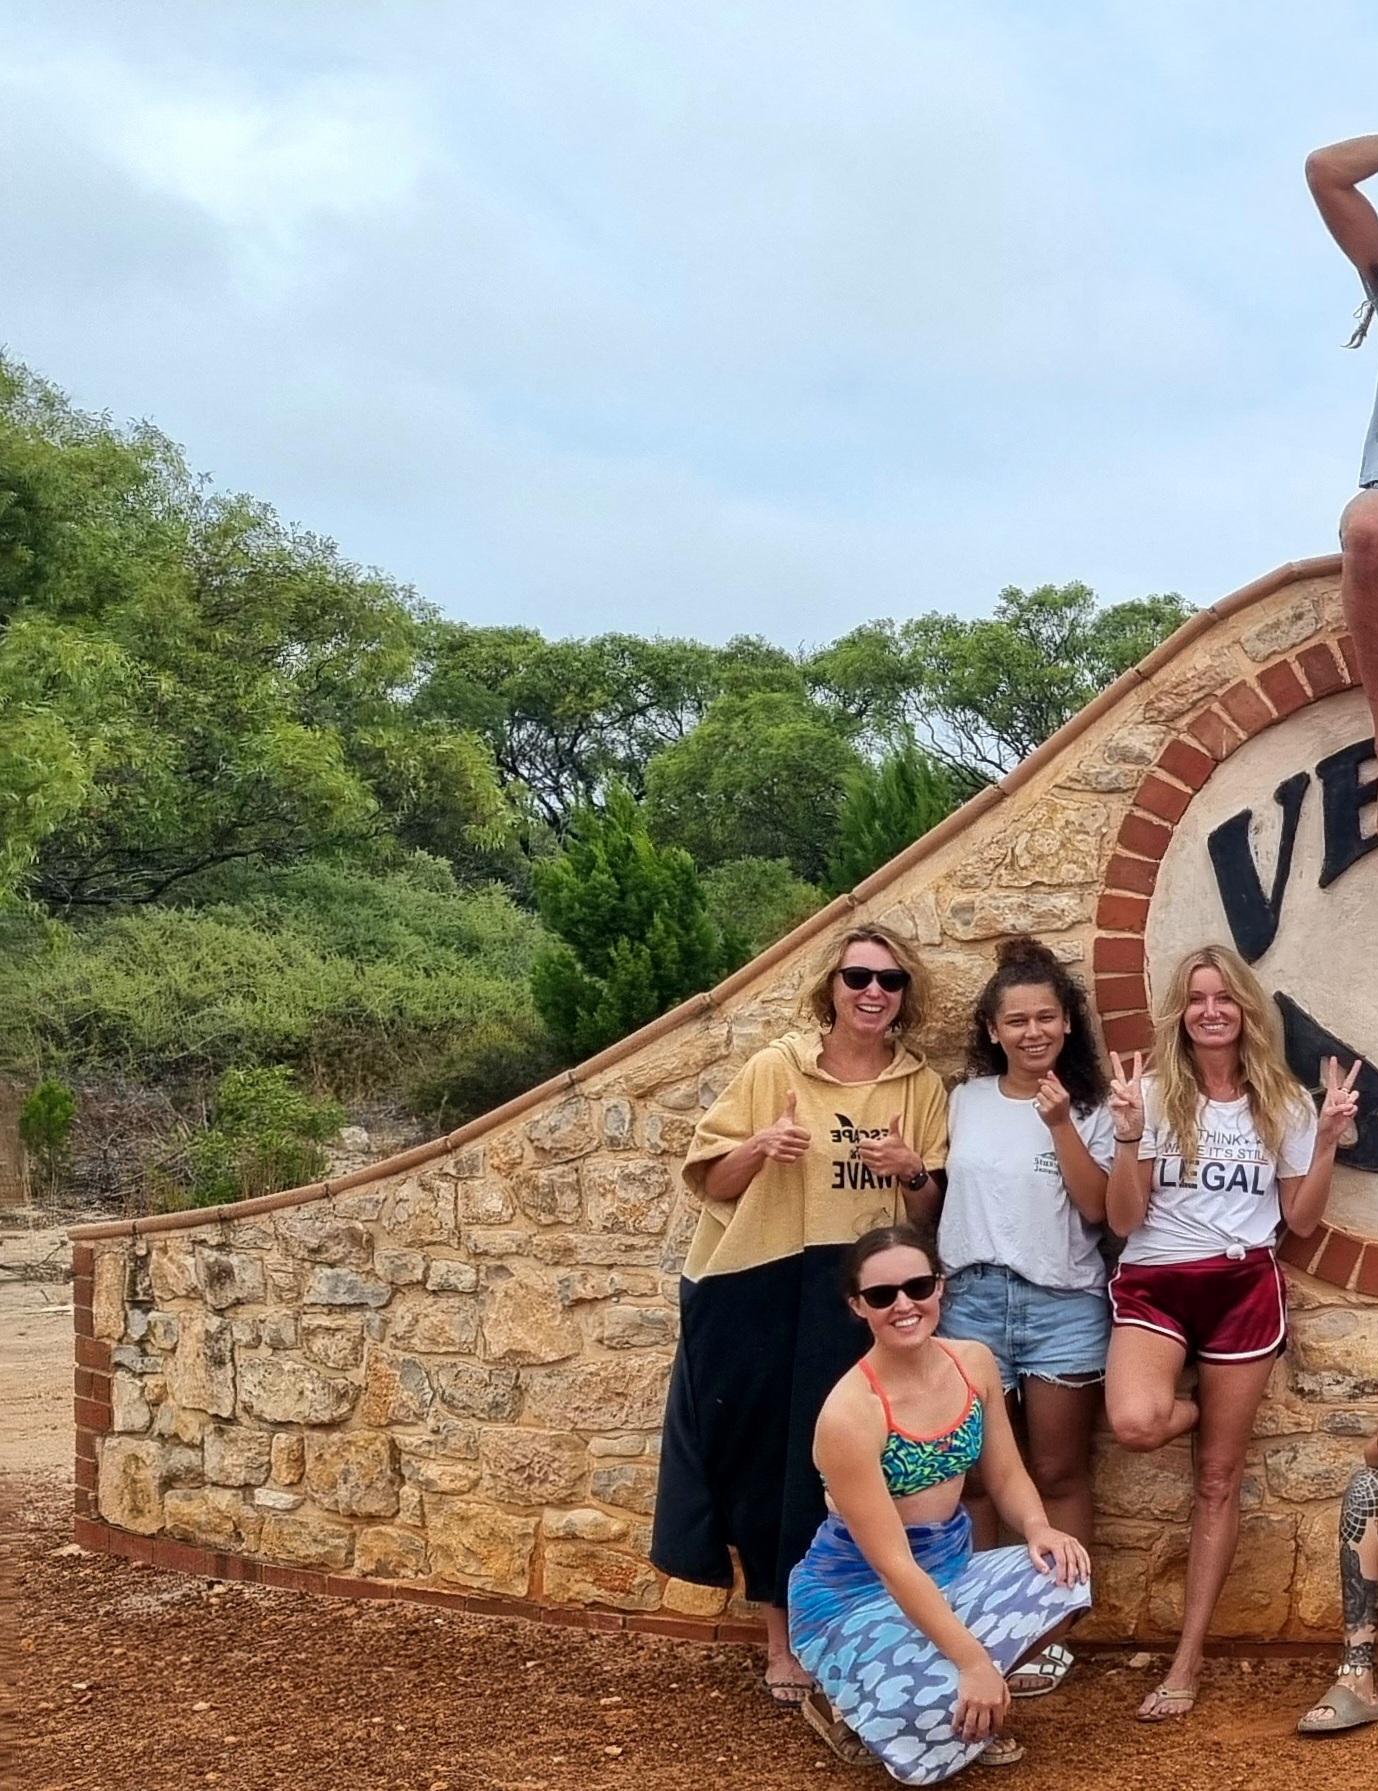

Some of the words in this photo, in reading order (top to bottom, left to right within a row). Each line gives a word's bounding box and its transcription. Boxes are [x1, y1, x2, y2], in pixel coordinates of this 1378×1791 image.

[1197, 1128, 1242, 1146] THINK
[1209, 1146, 1233, 1158] IT'S
[1160, 1158, 1265, 1196] LEGAL
